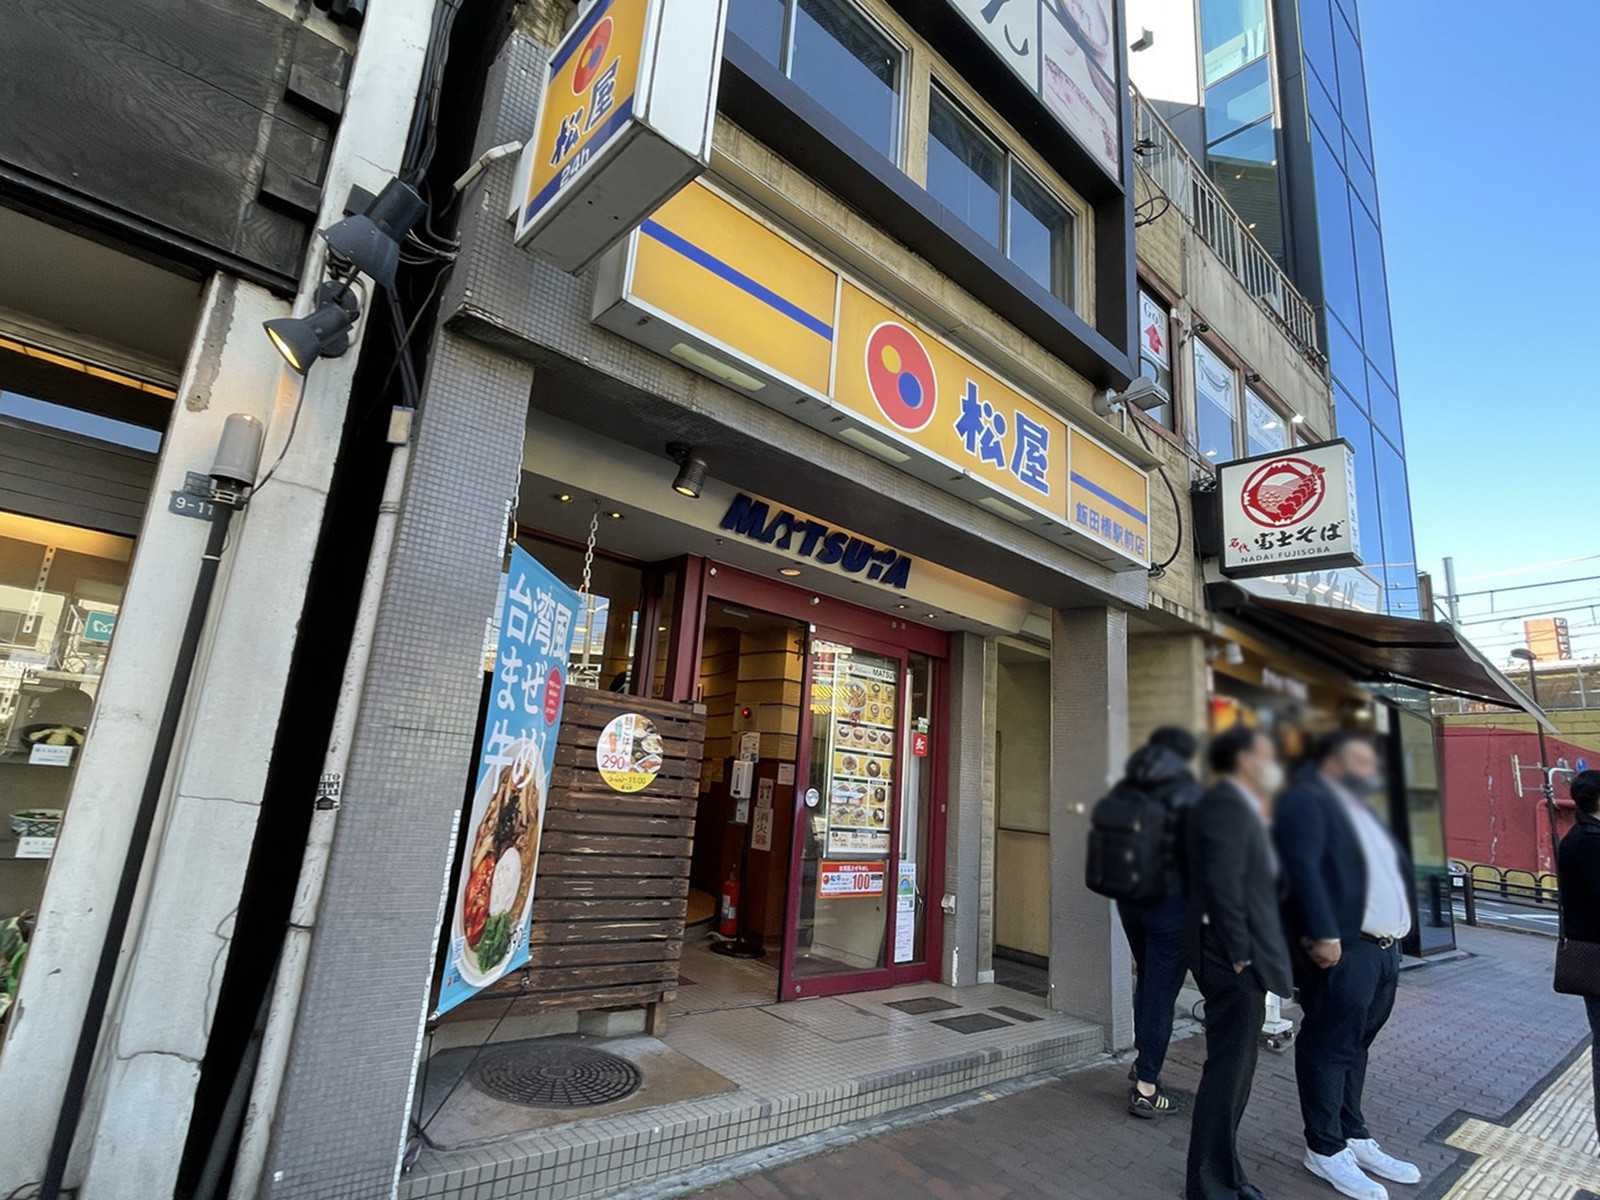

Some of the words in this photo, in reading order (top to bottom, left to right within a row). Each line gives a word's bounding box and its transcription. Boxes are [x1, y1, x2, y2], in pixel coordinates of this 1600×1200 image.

[549, 55, 621, 167] 松屋
[560, 148, 590, 188] 24h
[953, 378, 1050, 497] 松屋
[719, 492, 913, 590] MATSUYA
[1075, 501, 1145, 557] 飯田橋駅前店
[1240, 553, 1274, 564] NADAI
[1278, 546, 1331, 560] FUJISOBA
[507, 572, 573, 666] 台湾風
[496, 645, 548, 716] まぜ
[852, 873, 871, 890] 100
